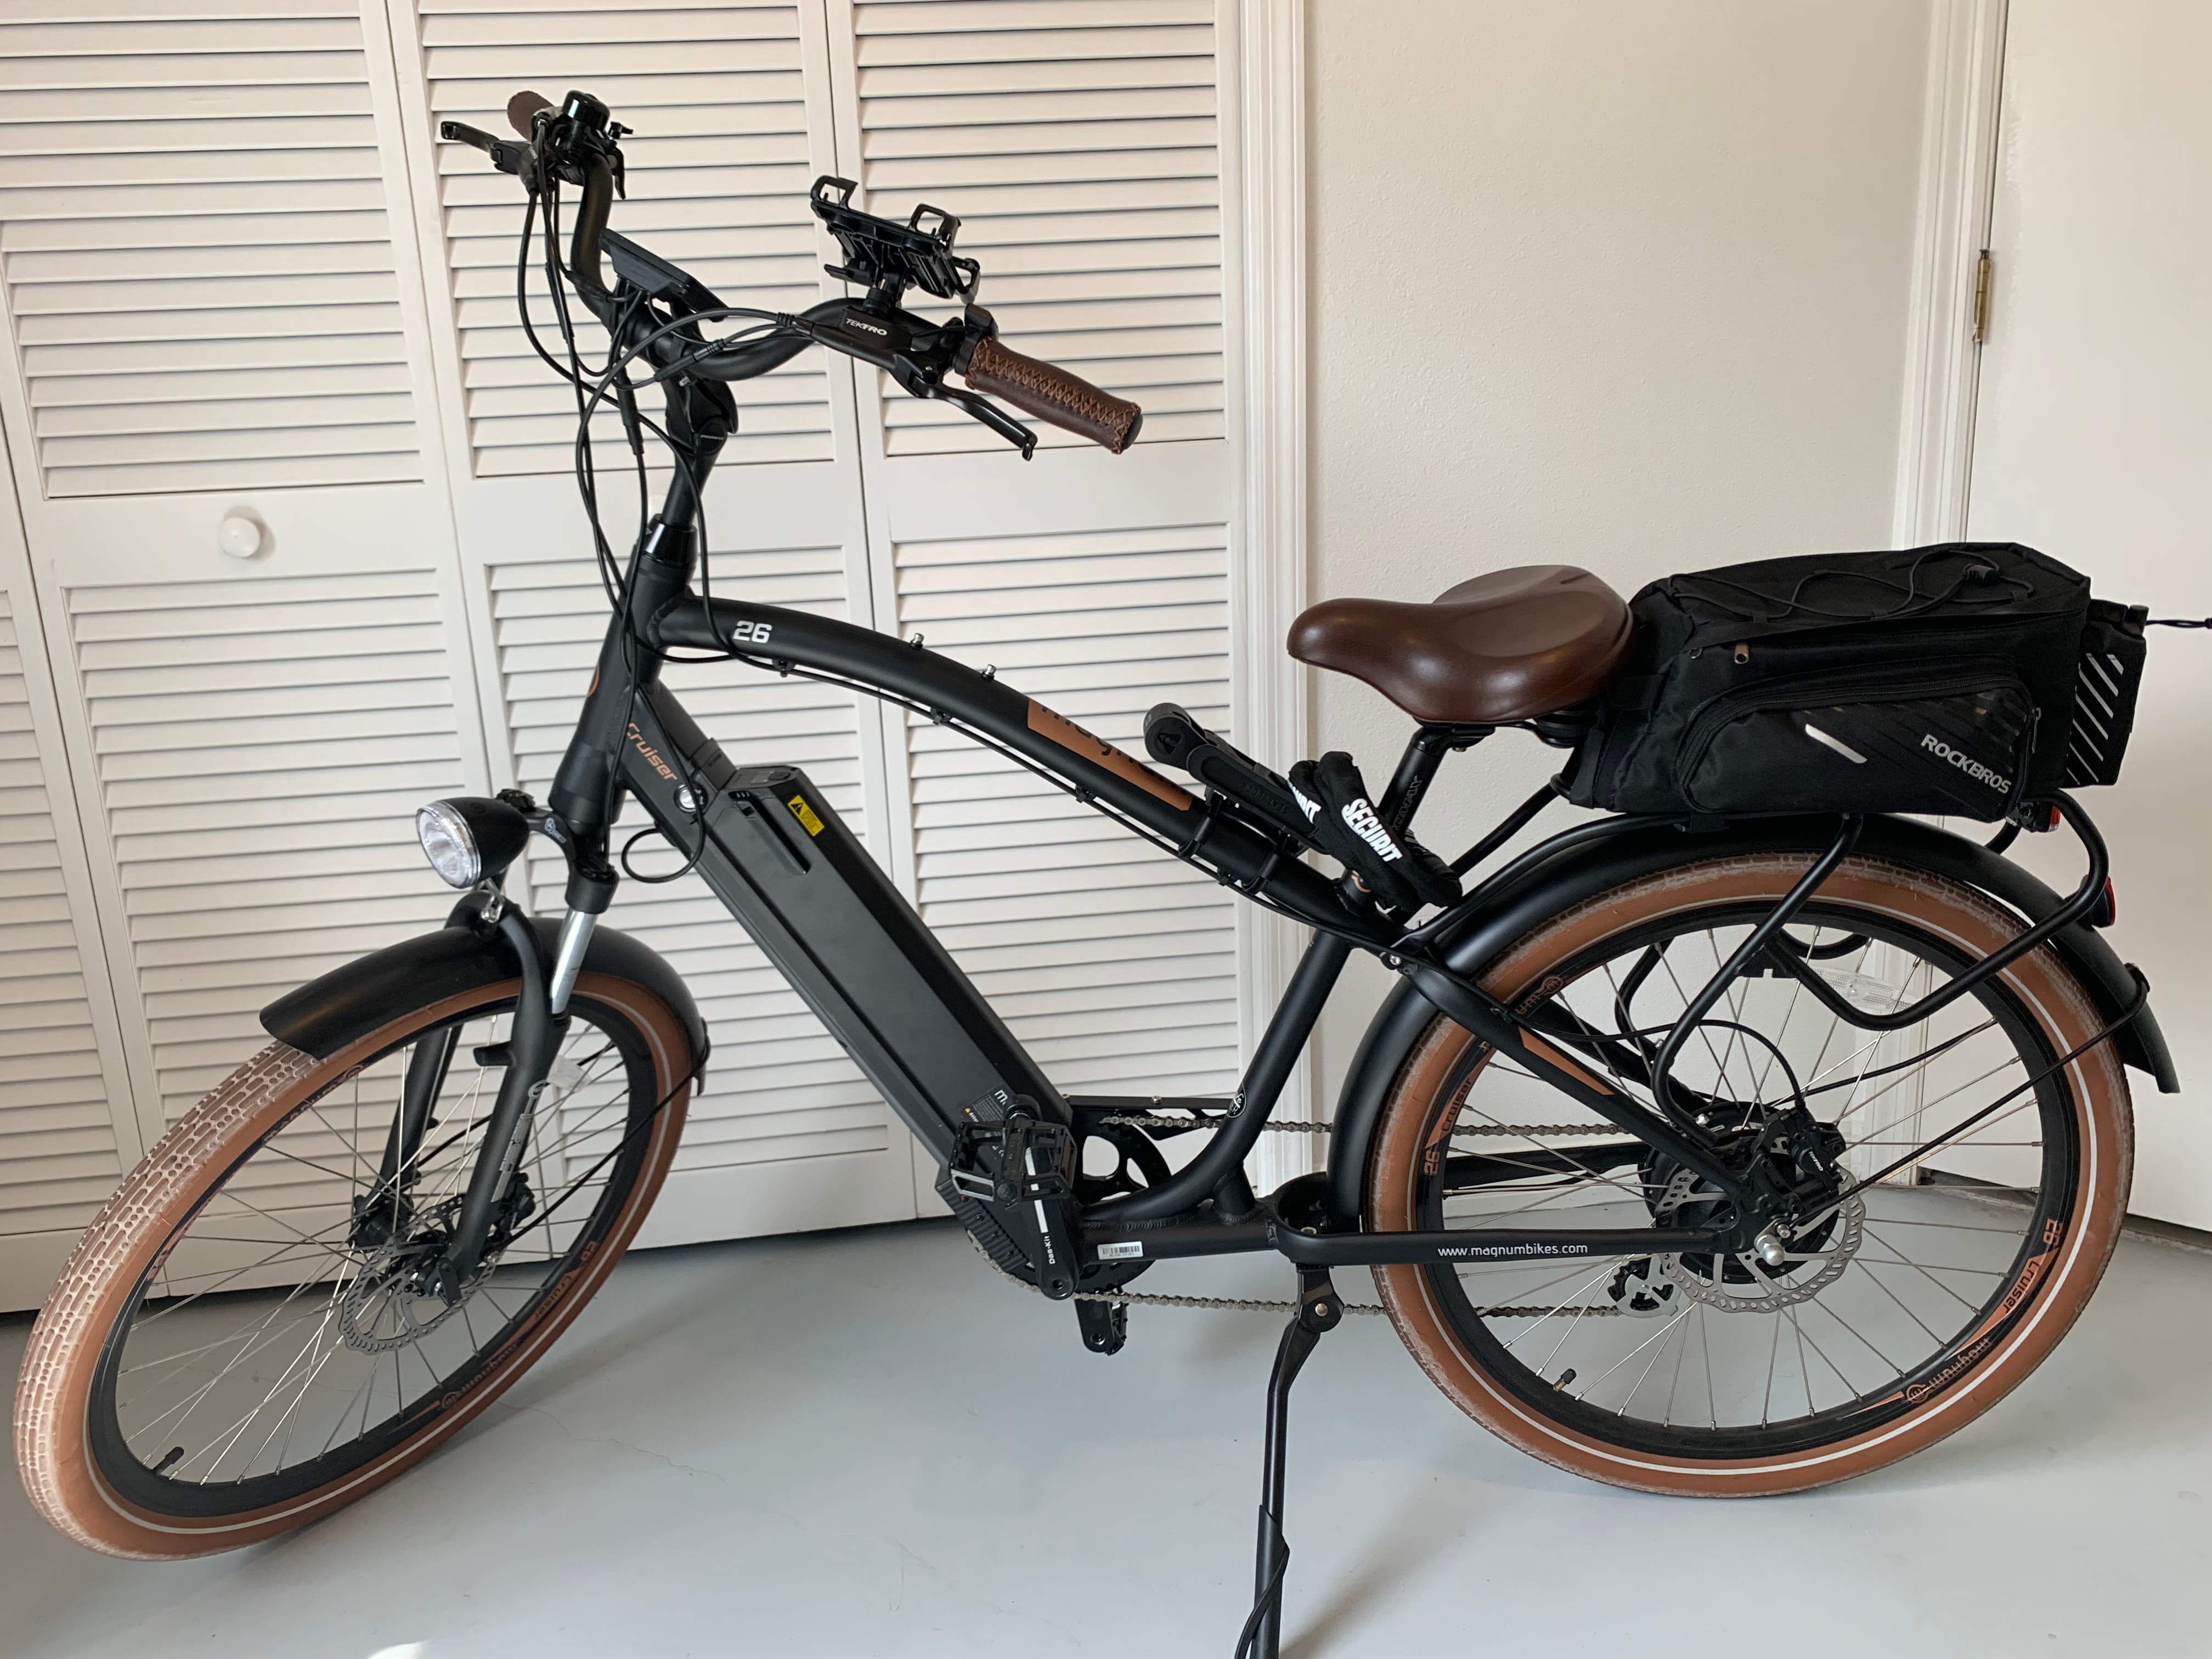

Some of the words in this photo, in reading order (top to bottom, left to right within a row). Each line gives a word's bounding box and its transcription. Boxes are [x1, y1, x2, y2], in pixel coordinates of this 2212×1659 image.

[845, 318, 888, 336] TEKTRO
[733, 620, 773, 644] 26
[627, 722, 678, 781] Cruiser
[1921, 733, 2012, 794] ROCKBROS
[1341, 798, 1403, 862] SECURIT
[1424, 1148, 1440, 1176] 26
[2043, 1218, 2064, 1246] 26
[1437, 1243, 1588, 1258] www.magnumbikes.com
[2003, 1260, 2041, 1314] Cruiser
